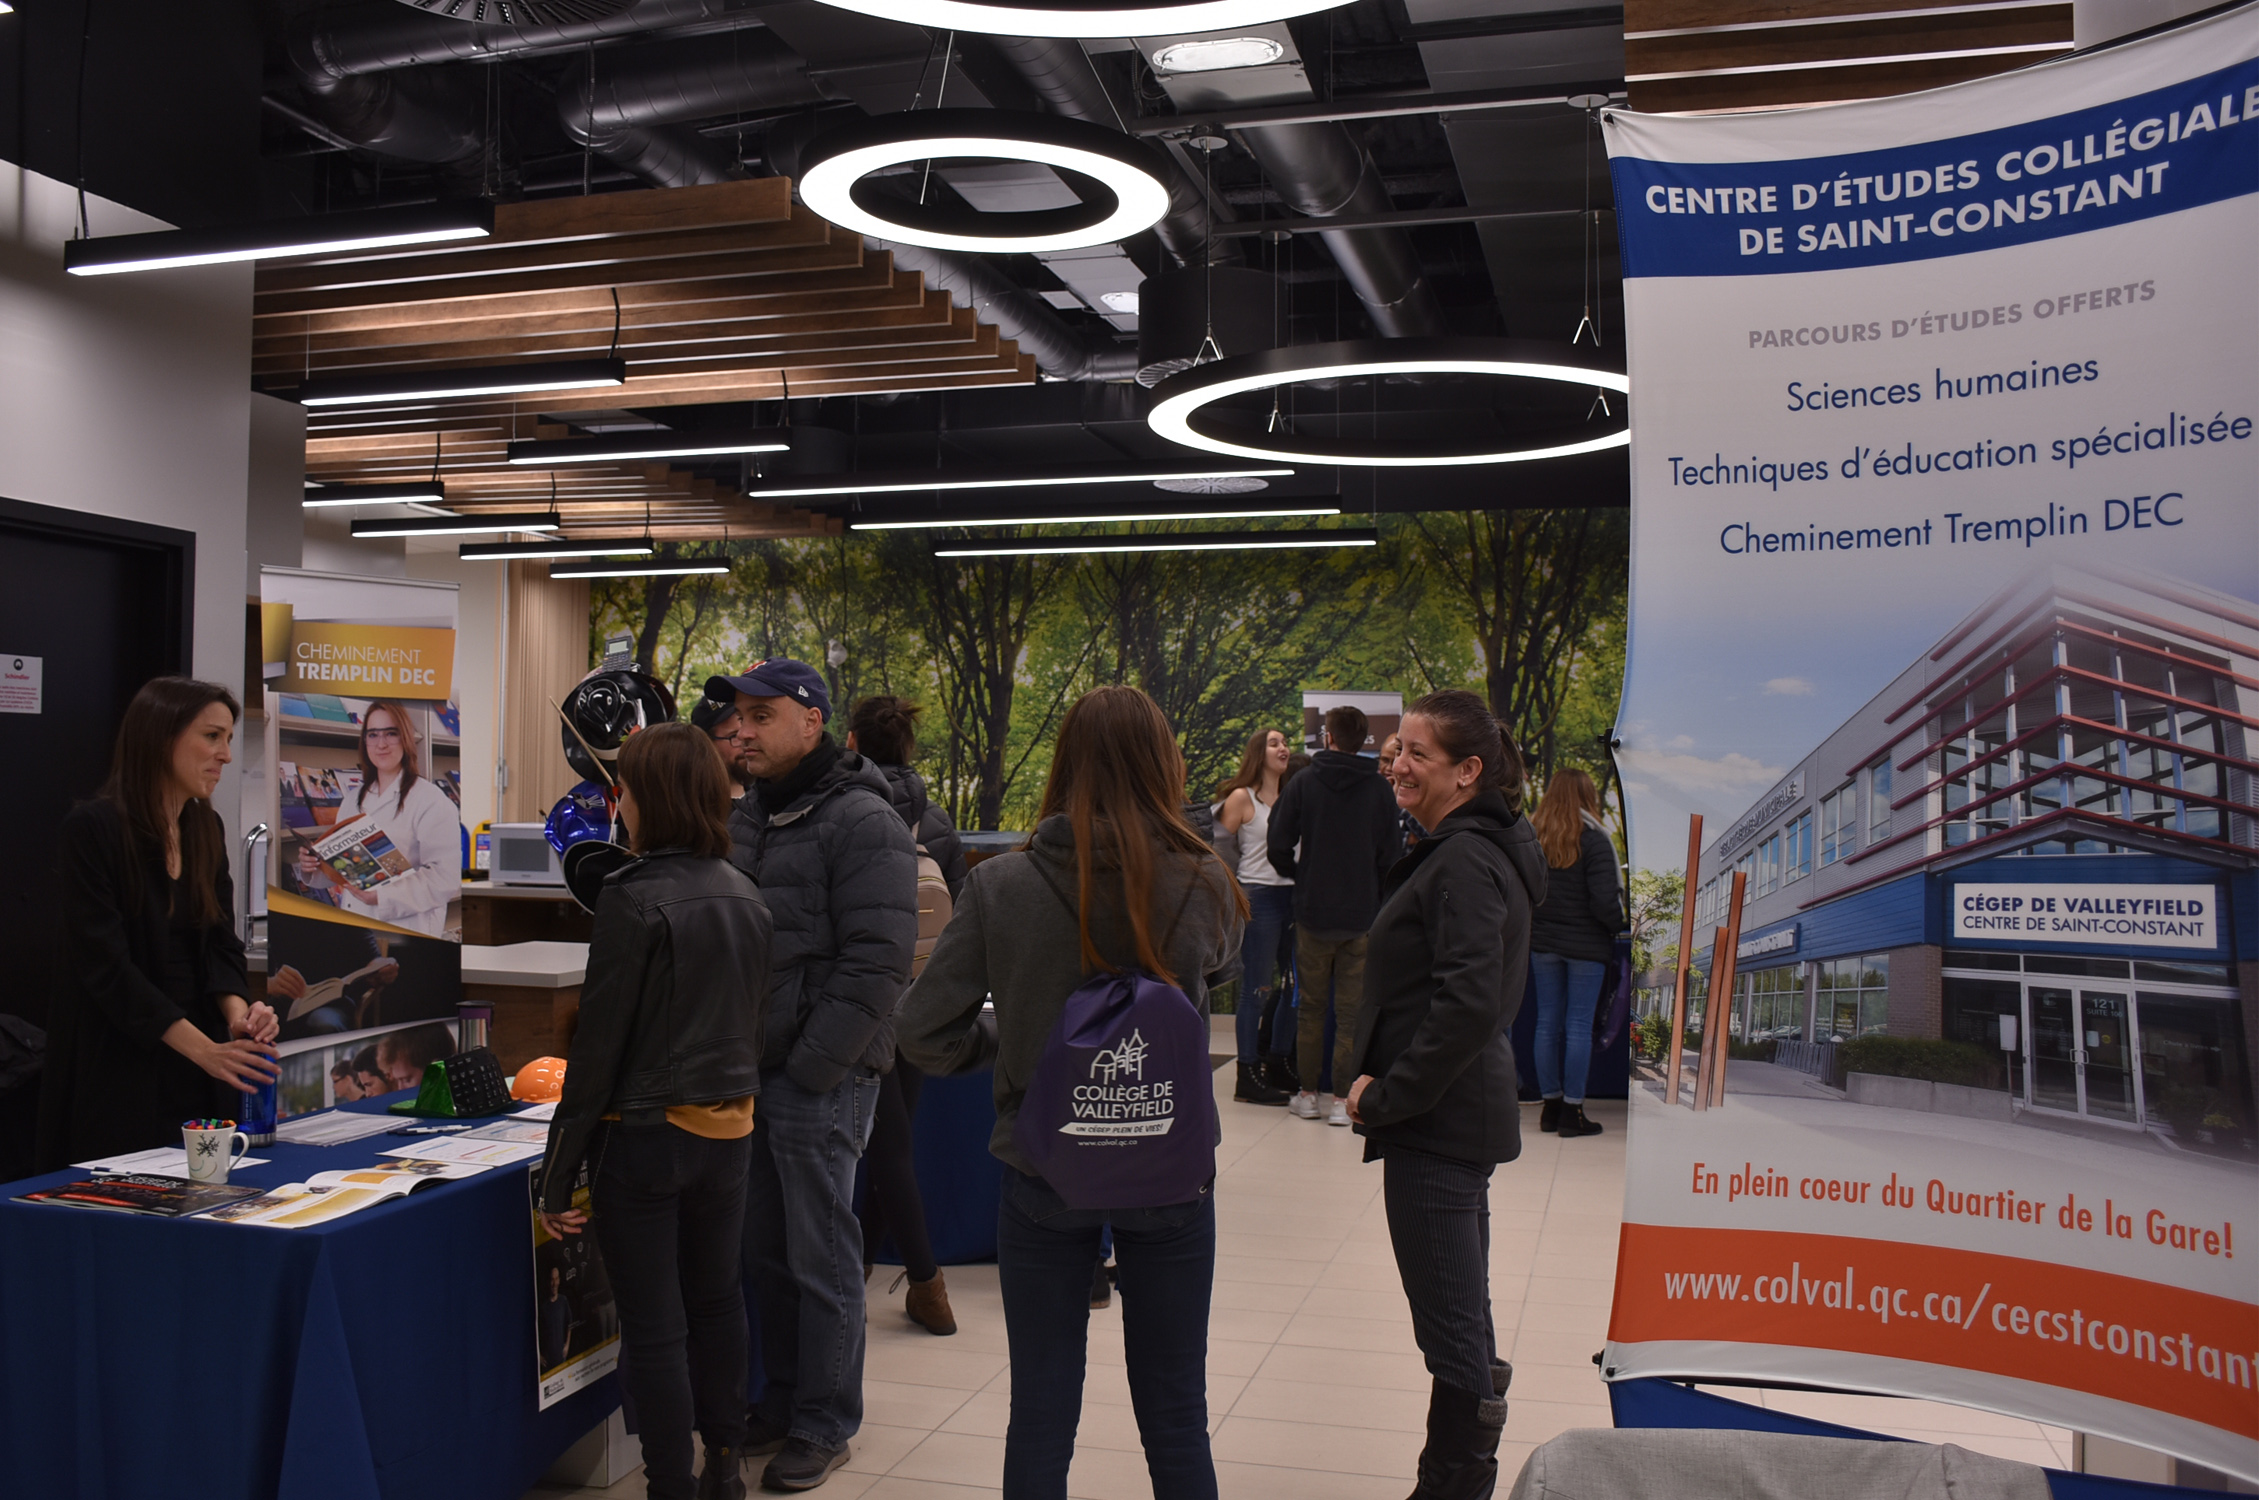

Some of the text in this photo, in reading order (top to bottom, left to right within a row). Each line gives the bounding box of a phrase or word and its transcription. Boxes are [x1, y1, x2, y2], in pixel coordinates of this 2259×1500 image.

[1646, 186, 1777, 214] CENTRE
[1793, 161, 1979, 210] D'ÉTUDES
[1740, 161, 2170, 255] DE SAINT-CONSTANT
[1749, 280, 2155, 348] PARCOURS D'ÉTUDES OFFERTS
[1787, 360, 2098, 411] Sciences humaines
[1668, 411, 2252, 491] Techniques d'éducation spécialisée
[1720, 492, 2183, 554] Cheminement Tremplin DEC
[297, 642, 421, 664] CHEMINEMENT
[296, 662, 434, 685] TREMPLIN DEC
[319, 823, 377, 857] informateur
[1963, 893, 2203, 916] CÉGEP DE VALLEYFIELD
[1963, 916, 2203, 936] CENTRE DE SAINT-CONSTANT
[2086, 1008, 2108, 1016] SUITE
[2093, 998, 2115, 1010] 121
[1073, 1081, 1173, 1101] COLLÈGE DE
[1072, 1099, 1173, 1118] VALLEYFIELD
[1112, 1125, 1133, 1133] PLEIN
[1133, 1125, 1144, 1133] DE
[1077, 1139, 1138, 1147] www.colval.qc.ca
[1692, 1162, 2232, 1258] En plein coeur du Quartier de la Gare!
